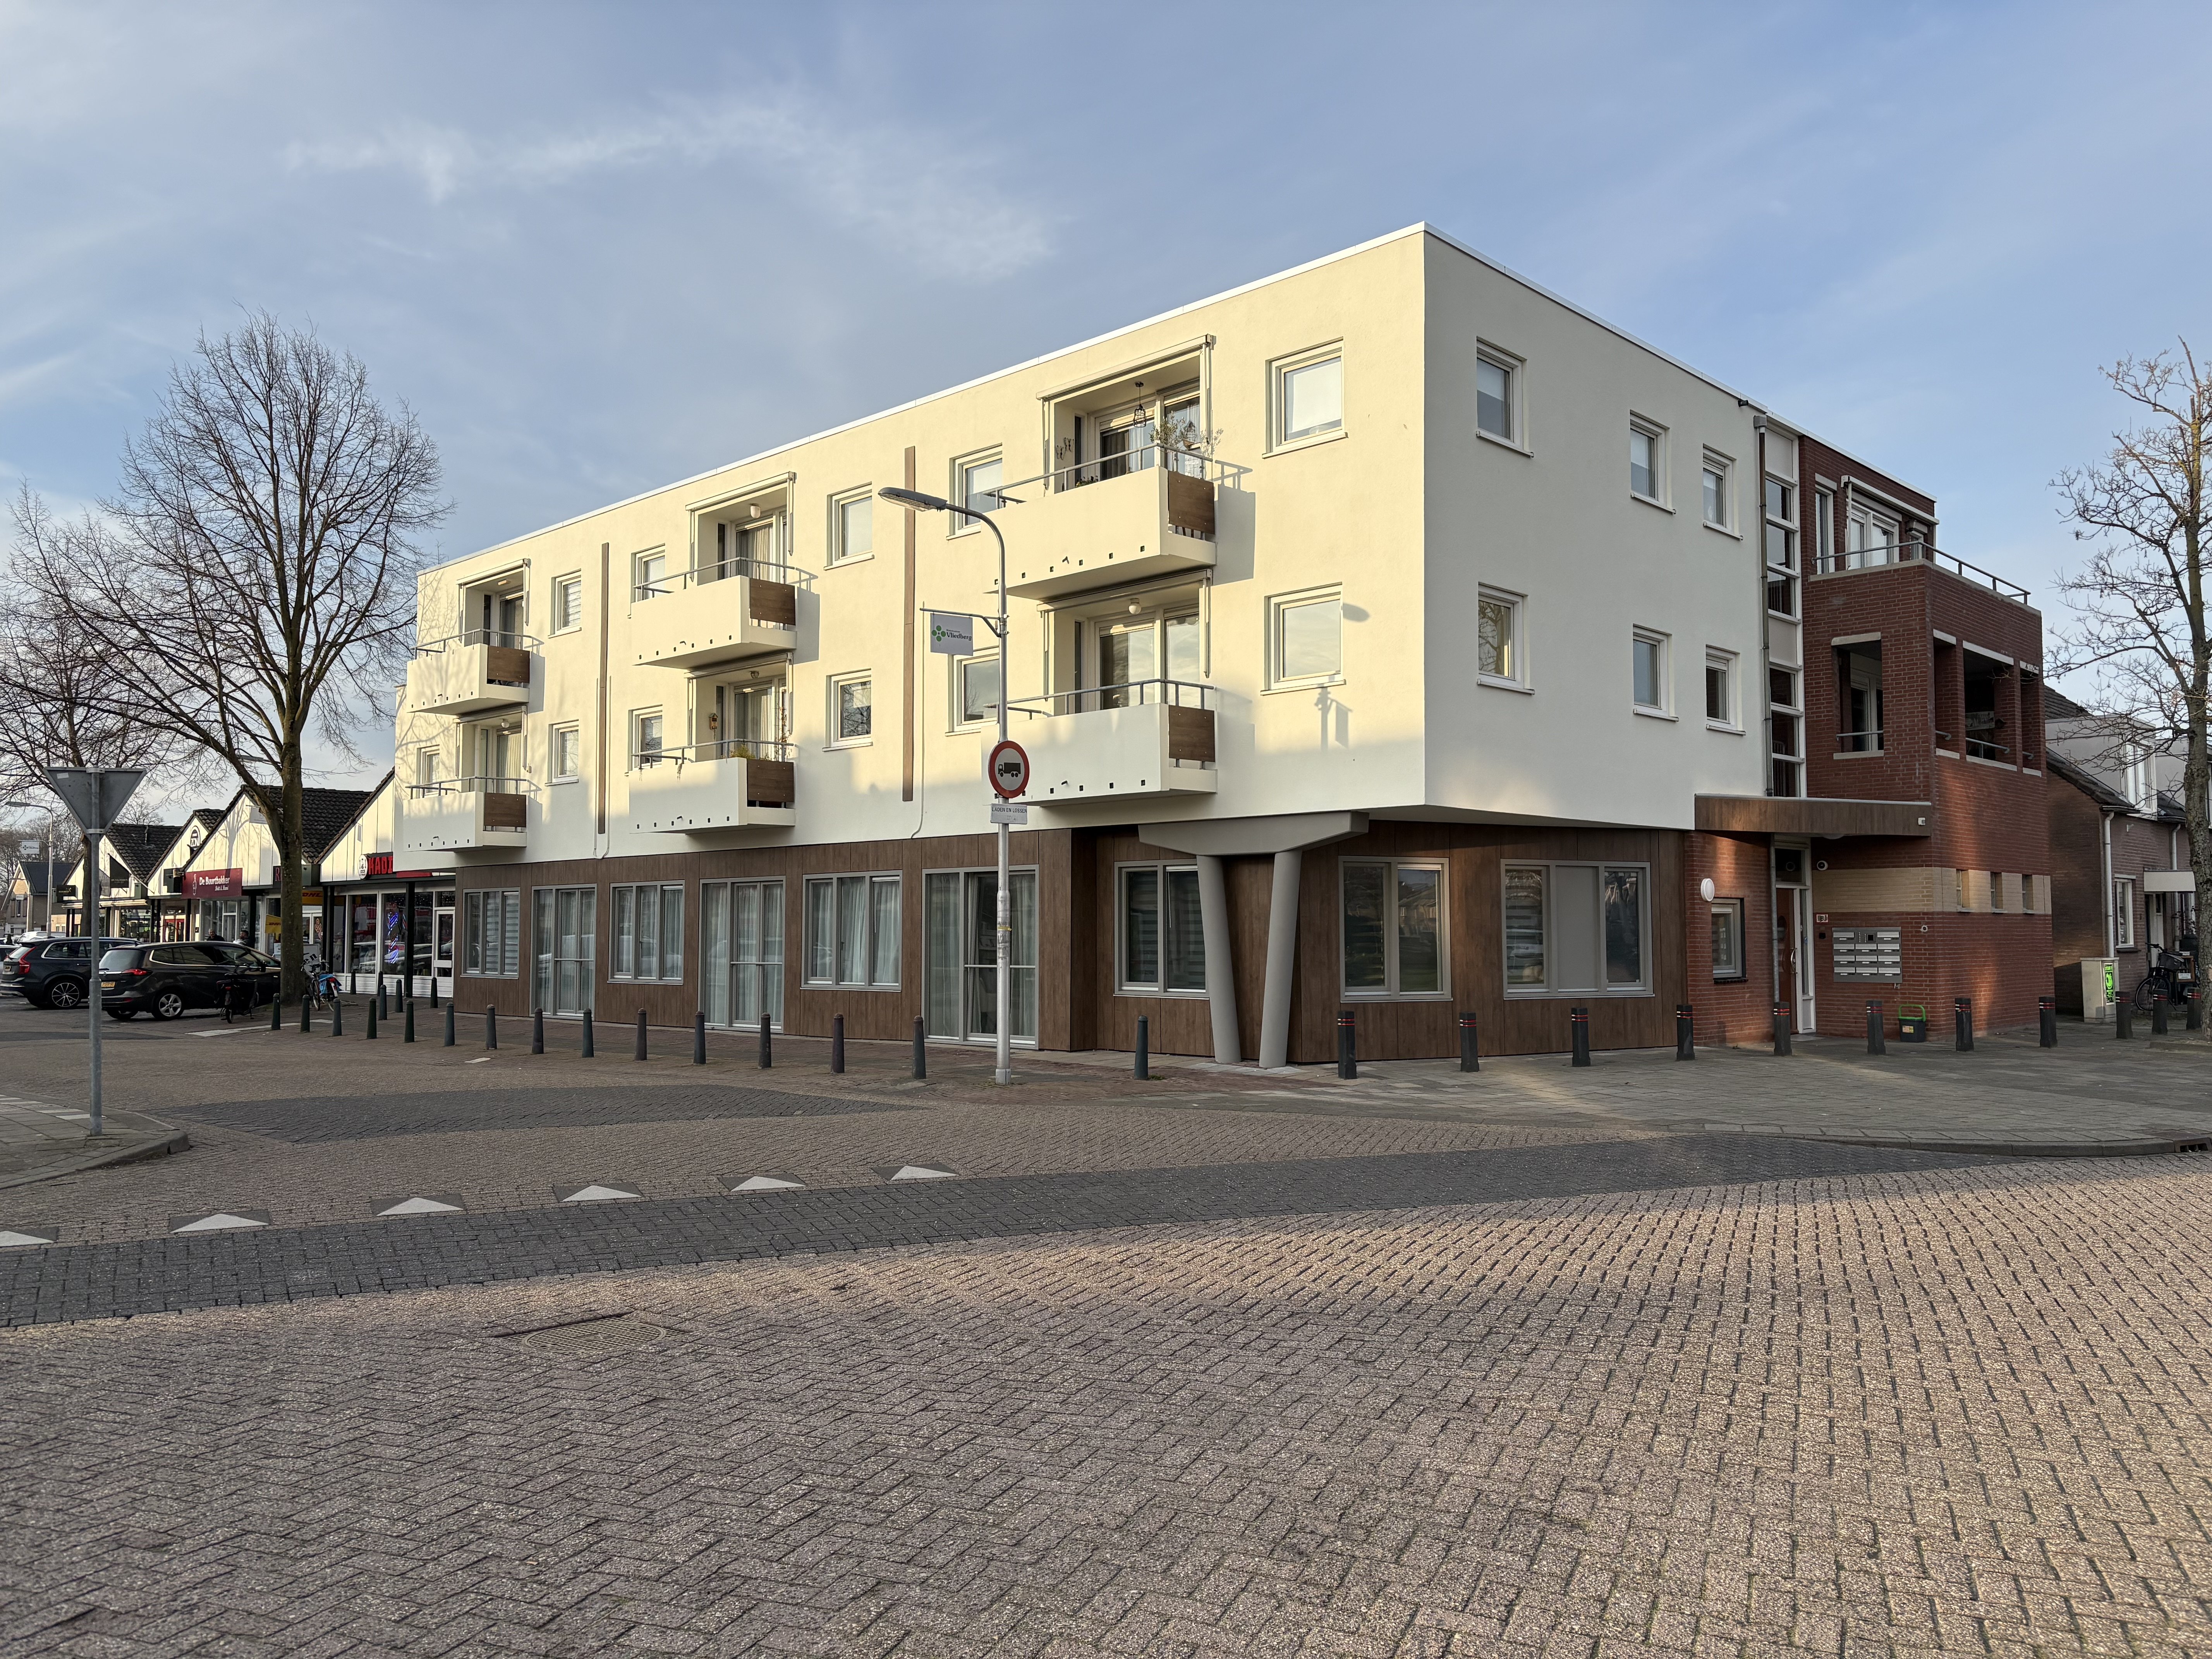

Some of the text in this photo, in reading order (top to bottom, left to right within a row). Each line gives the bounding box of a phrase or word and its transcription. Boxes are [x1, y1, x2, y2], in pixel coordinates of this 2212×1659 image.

[946, 632, 972, 641] Vliedberg
[199, 875, 230, 885] De Buurtbakker
